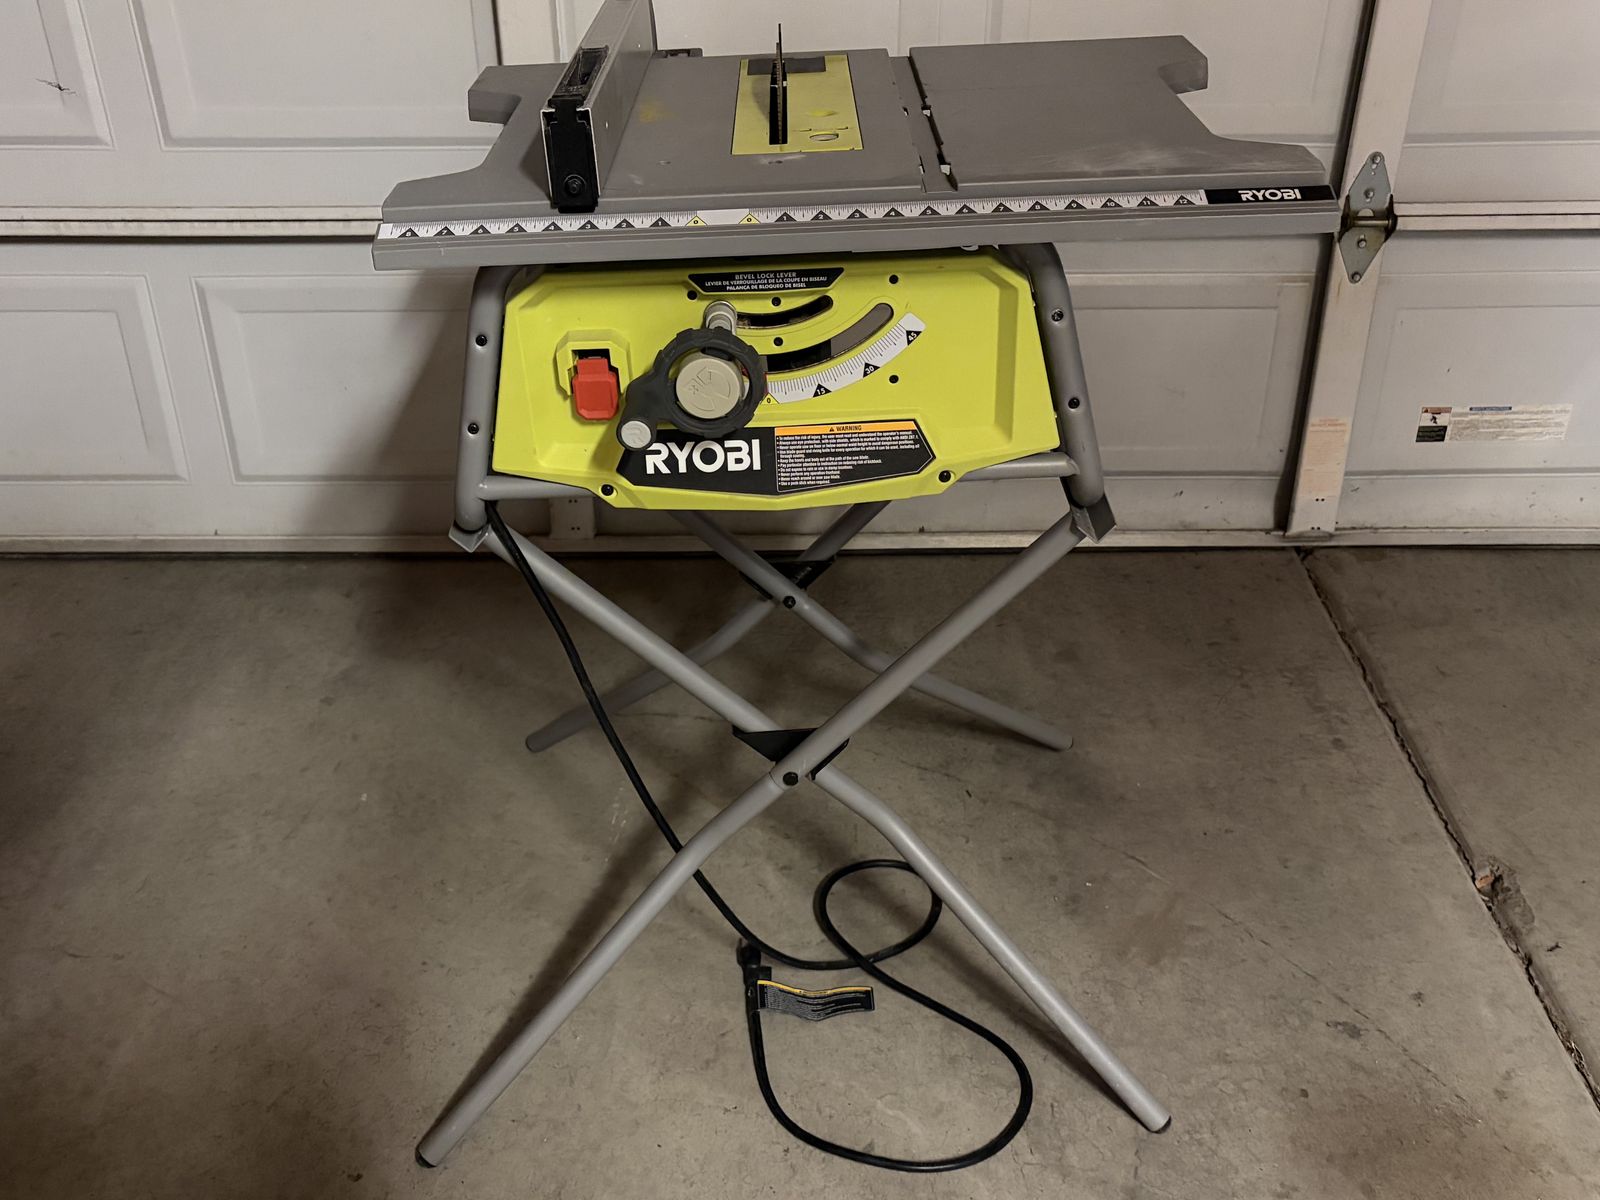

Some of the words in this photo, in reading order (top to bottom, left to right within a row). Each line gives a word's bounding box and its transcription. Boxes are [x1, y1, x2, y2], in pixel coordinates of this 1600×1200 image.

[1238, 188, 1302, 201] RYOBI
[908, 331, 917, 341] 45
[865, 365, 875, 375] 30
[816, 387, 826, 395] 15
[645, 438, 761, 475] RYOBI
